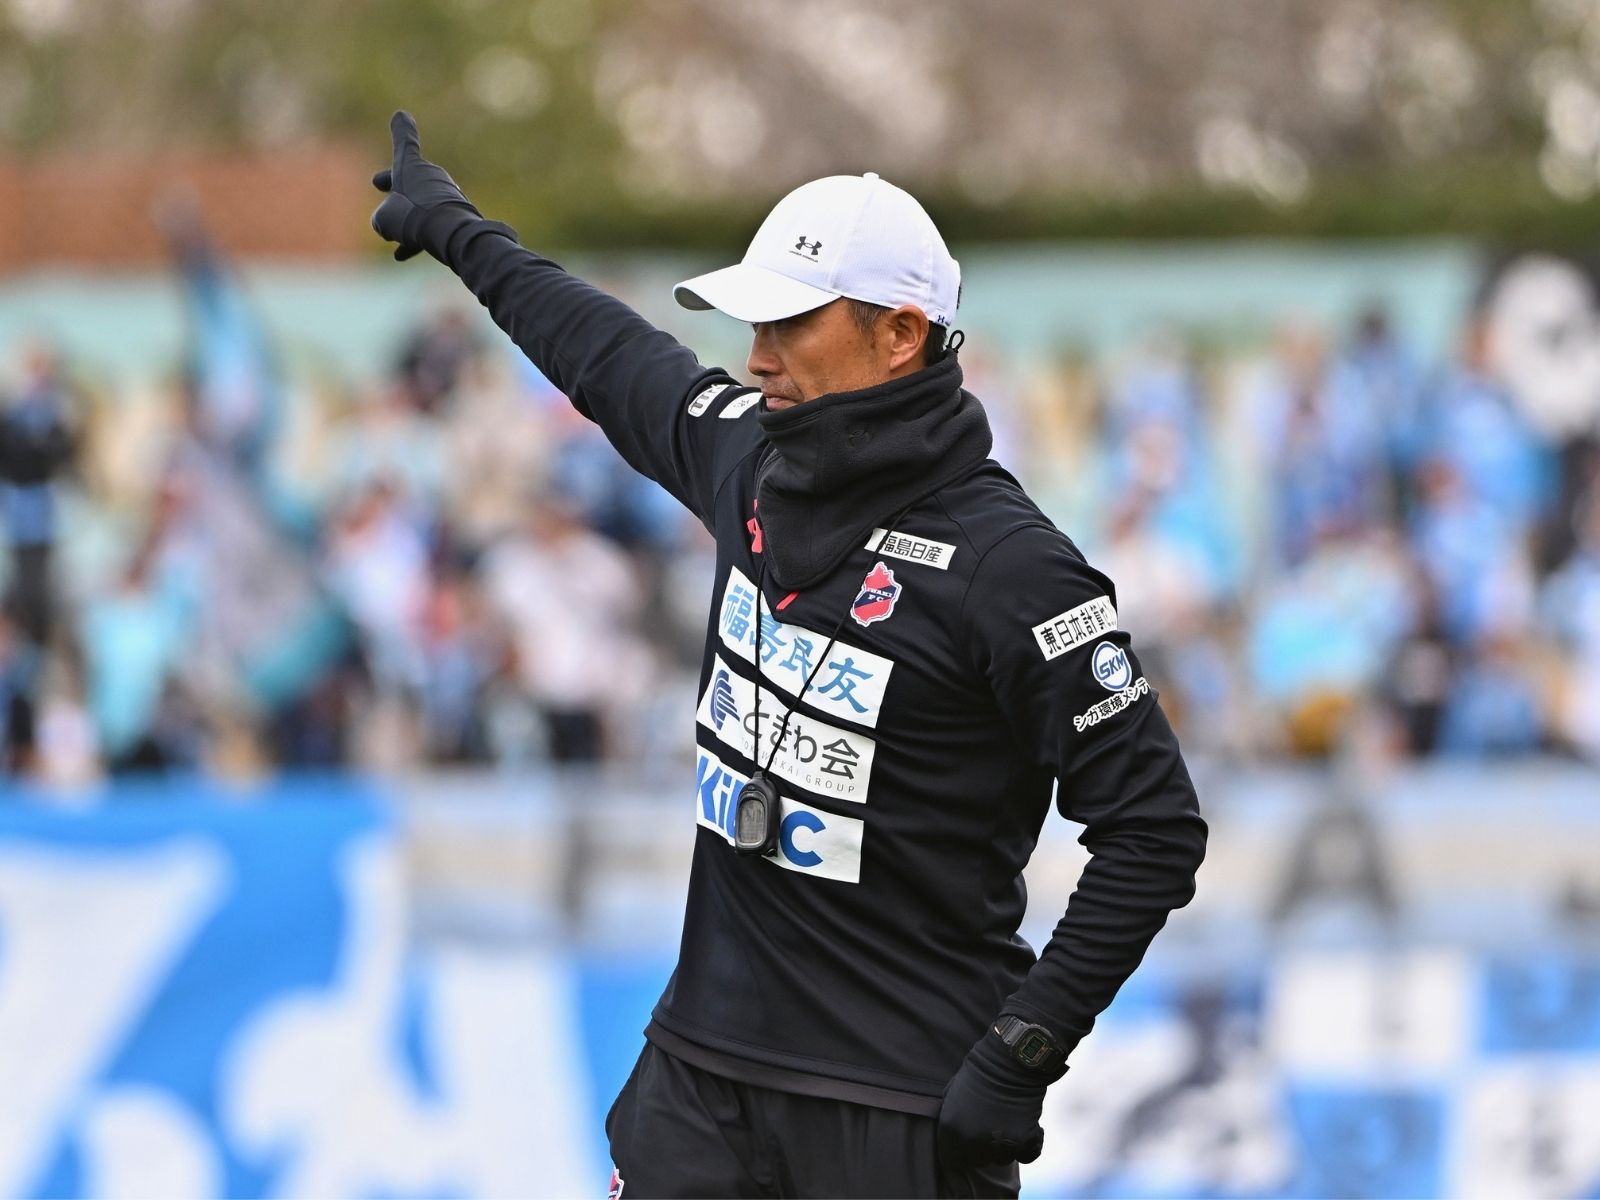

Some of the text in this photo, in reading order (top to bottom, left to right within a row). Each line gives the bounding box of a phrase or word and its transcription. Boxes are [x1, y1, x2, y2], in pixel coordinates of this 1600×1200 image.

[884, 534, 943, 563] 福島日産
[722, 583, 874, 714] 福島民友
[1099, 651, 1125, 680] SKM
[743, 699, 860, 780] ときわ会
[805, 774, 855, 793] GROUP
